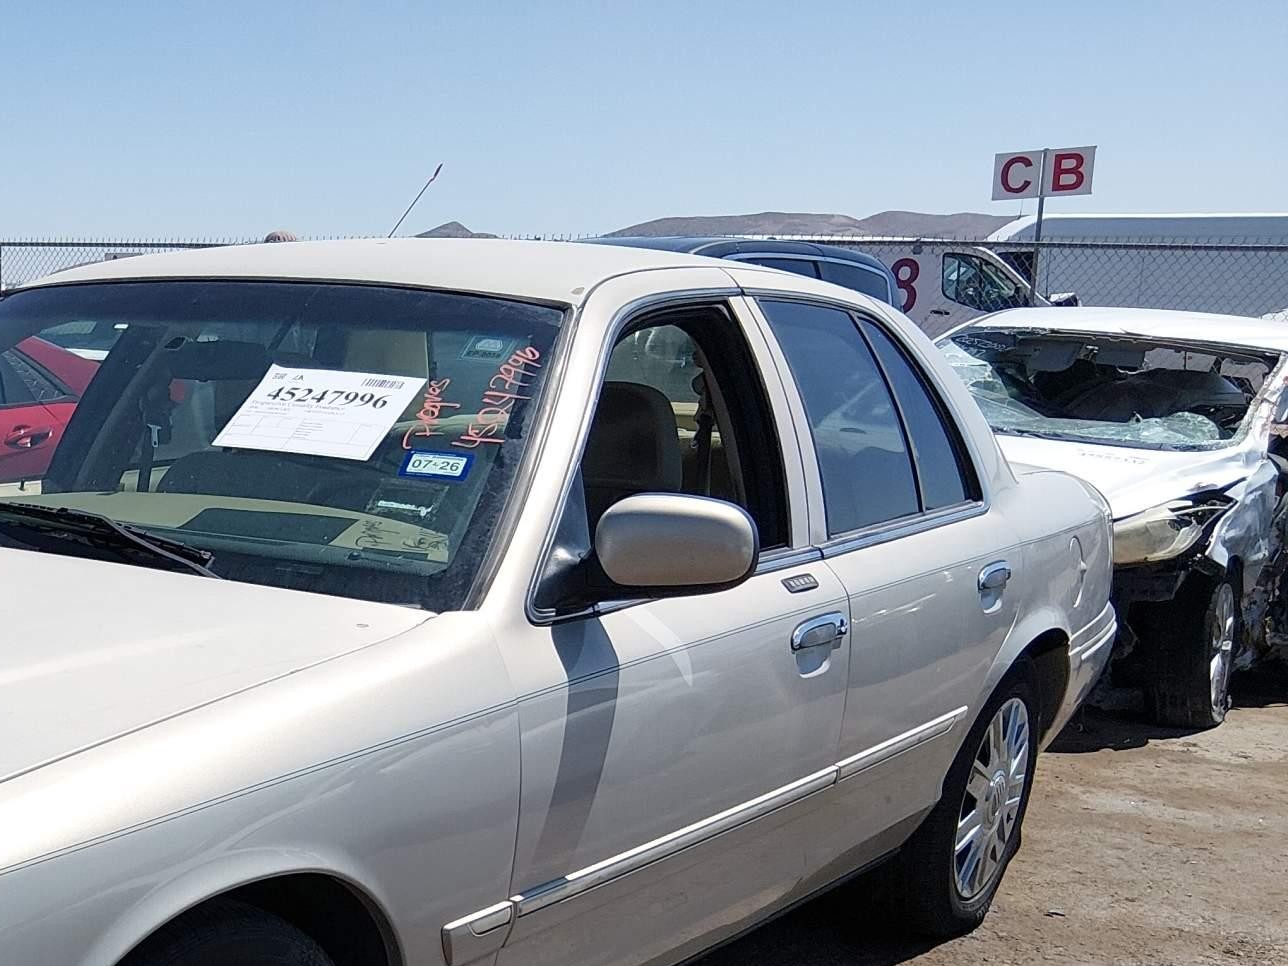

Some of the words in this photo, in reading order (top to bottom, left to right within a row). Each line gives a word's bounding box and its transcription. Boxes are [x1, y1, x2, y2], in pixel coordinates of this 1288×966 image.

[1000, 155, 1034, 194] C
[1051, 152, 1085, 192] B
[266, 386, 392, 410] 45247996
